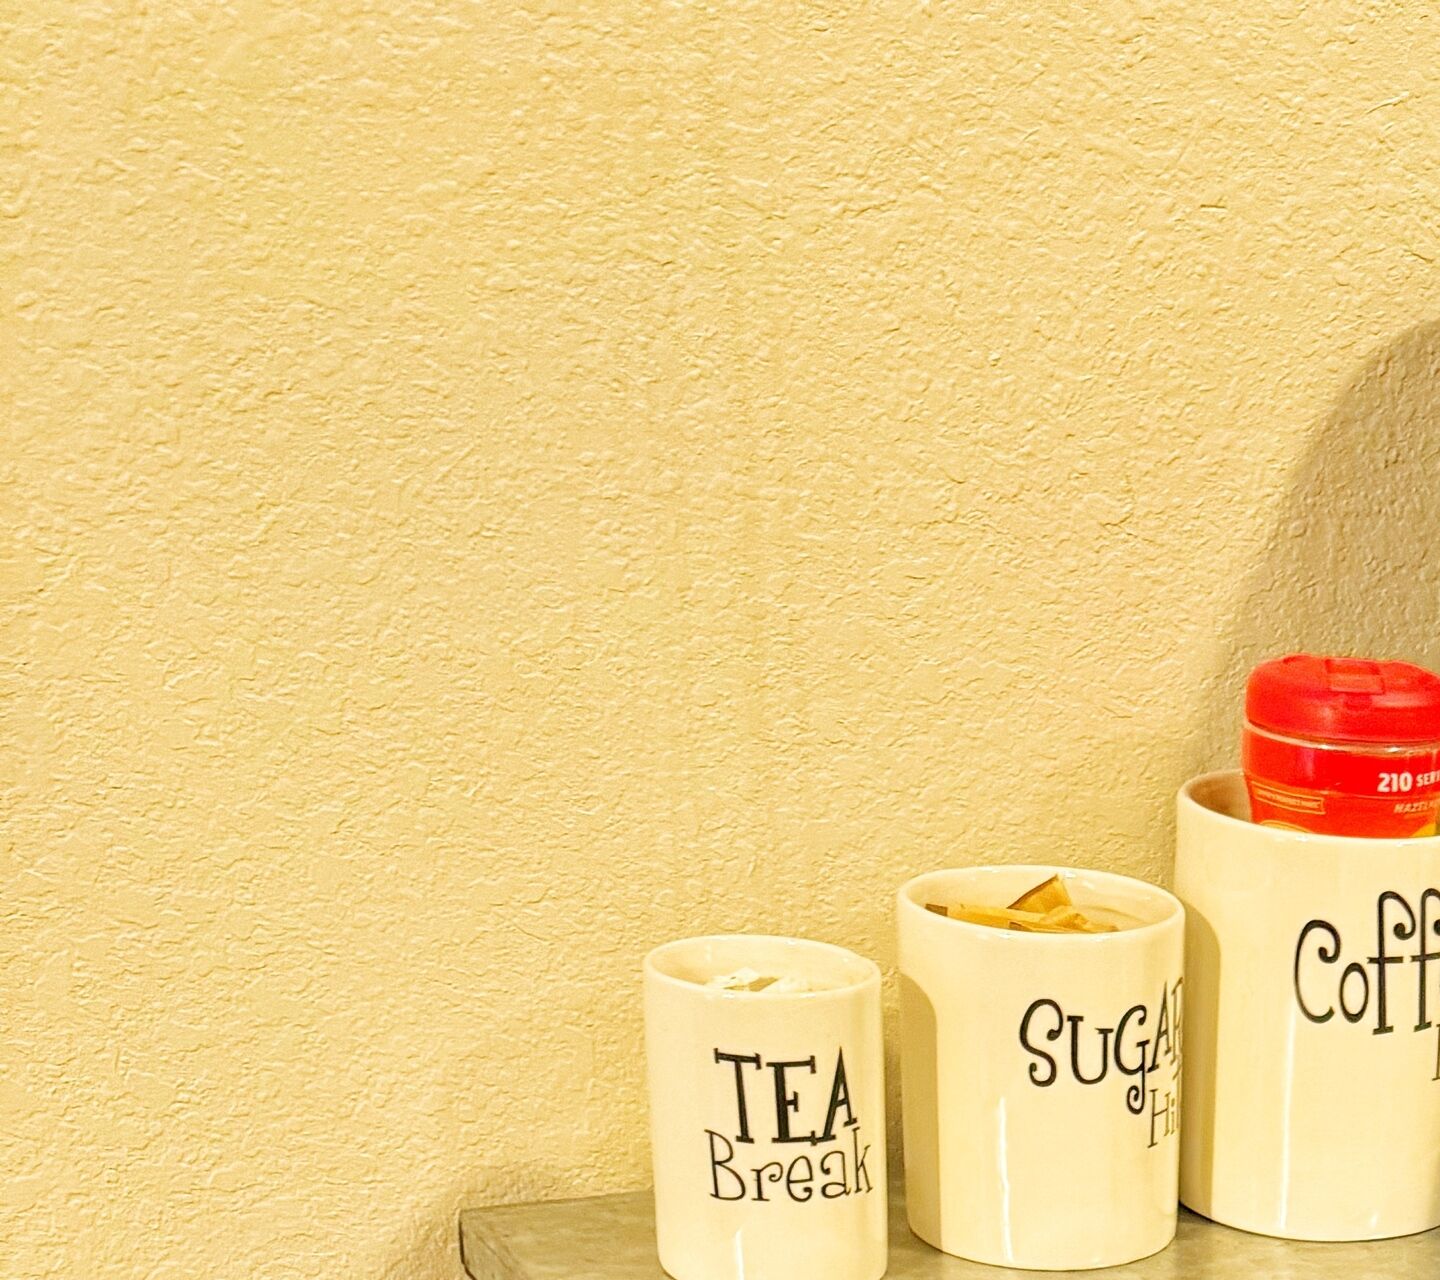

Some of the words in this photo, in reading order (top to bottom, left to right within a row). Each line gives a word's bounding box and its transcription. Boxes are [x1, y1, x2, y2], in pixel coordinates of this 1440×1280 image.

[1377, 772, 1413, 793] 210
[713, 1046, 857, 1145] TEA
[704, 1126, 874, 1202] Break
